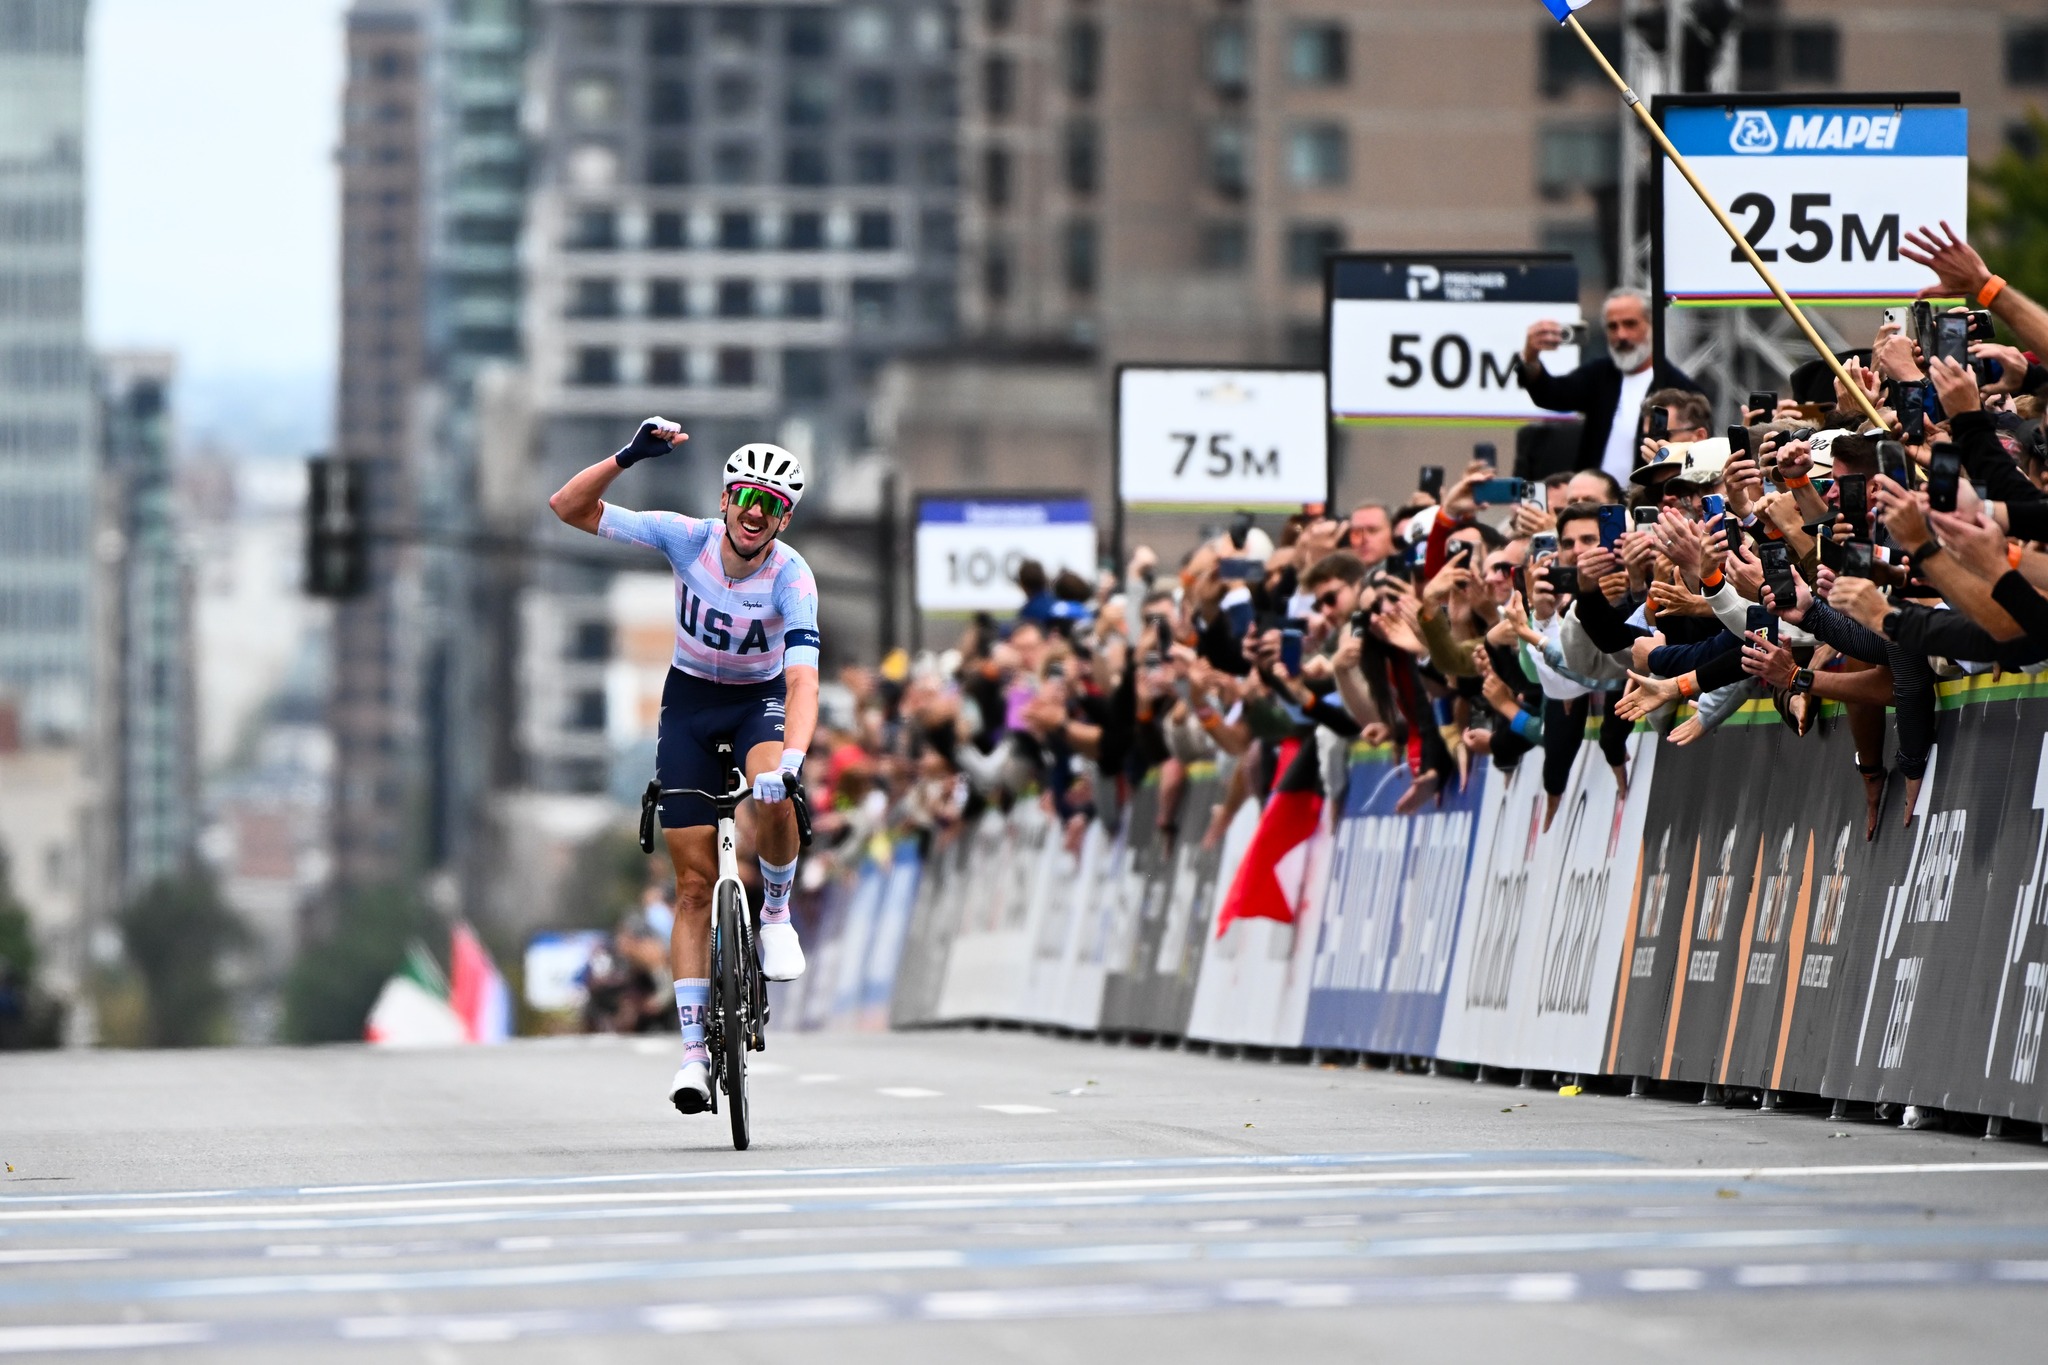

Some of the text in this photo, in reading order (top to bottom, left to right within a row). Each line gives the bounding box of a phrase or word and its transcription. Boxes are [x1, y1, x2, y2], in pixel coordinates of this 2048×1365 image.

[1783, 114, 1902, 150] MAPEI
[1729, 191, 1900, 264] 25M
[1386, 333, 1524, 389] 50M
[1168, 430, 1280, 480] 75M
[680, 582, 770, 655] USA
